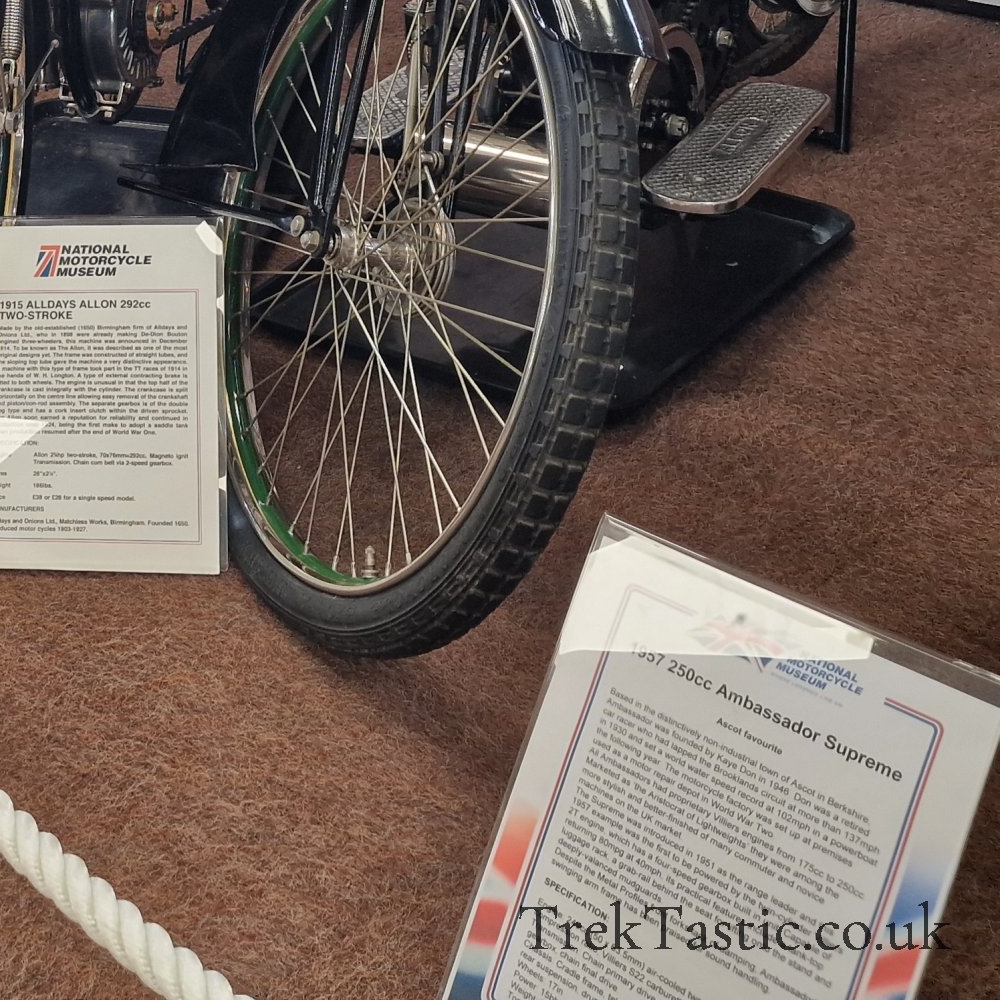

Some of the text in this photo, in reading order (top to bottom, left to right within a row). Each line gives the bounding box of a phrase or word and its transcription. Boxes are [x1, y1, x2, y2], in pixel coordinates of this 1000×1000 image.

[58, 255, 152, 266] MOTORCYCLE
[61, 244, 129, 254] NATIONAL
[56, 266, 116, 277] MUSEUM
[0, 299, 150, 309] 1915 ALLDAYS ALLON 292cc
[0, 310, 72, 320] TWO-STROKE
[776, 662, 827, 689] MUSEUM
[667, 659, 712, 690] 250cc
[715, 683, 821, 742] Ambassador
[823, 734, 902, 782] Supreme
[715, 717, 782, 755] Ascot favourite
[609, 686, 634, 705] Based
[643, 703, 656, 716] the
[656, 712, 702, 740] distinctively
[702, 735, 758, 768] non-industrial
[758, 762, 779, 778] town
[789, 778, 816, 797] Ascot
[602, 708, 615, 718] car
[616, 714, 636, 728] racer
[636, 725, 653, 738] who
[654, 732, 670, 747] had
[670, 741, 698, 762] lapped
[698, 755, 712, 769] the
[712, 763, 759, 793] Brooklands
[760, 789, 786, 807] circuit
[797, 808, 820, 824] more
[821, 819, 841, 835] than
[844, 831, 880, 855] 137mph
[605, 697, 653, 726] Ambassador
[654, 722, 670, 735] was
[671, 729, 704, 752] founded
[715, 752, 737, 770] Kaye
[738, 763, 756, 780] Don
[793, 791, 811, 808] Don
[813, 803, 831, 817] was
[840, 817, 870, 837] retired
[581, 767, 601, 782] more
[602, 778, 626, 796] stylish
[626, 792, 643, 805] and
[643, 799, 699, 836] better-finished
[709, 837, 733, 855] many
[733, 850, 776, 878] commuter
[777, 874, 795, 888] and
[795, 884, 824, 904] novice
[585, 755, 621, 780] Marketed
[647, 790, 685, 816] Aristocrat
[749, 845, 769, 862] they
[770, 857, 791, 873] were
[792, 870, 823, 892] among
[824, 885, 839, 899] the
